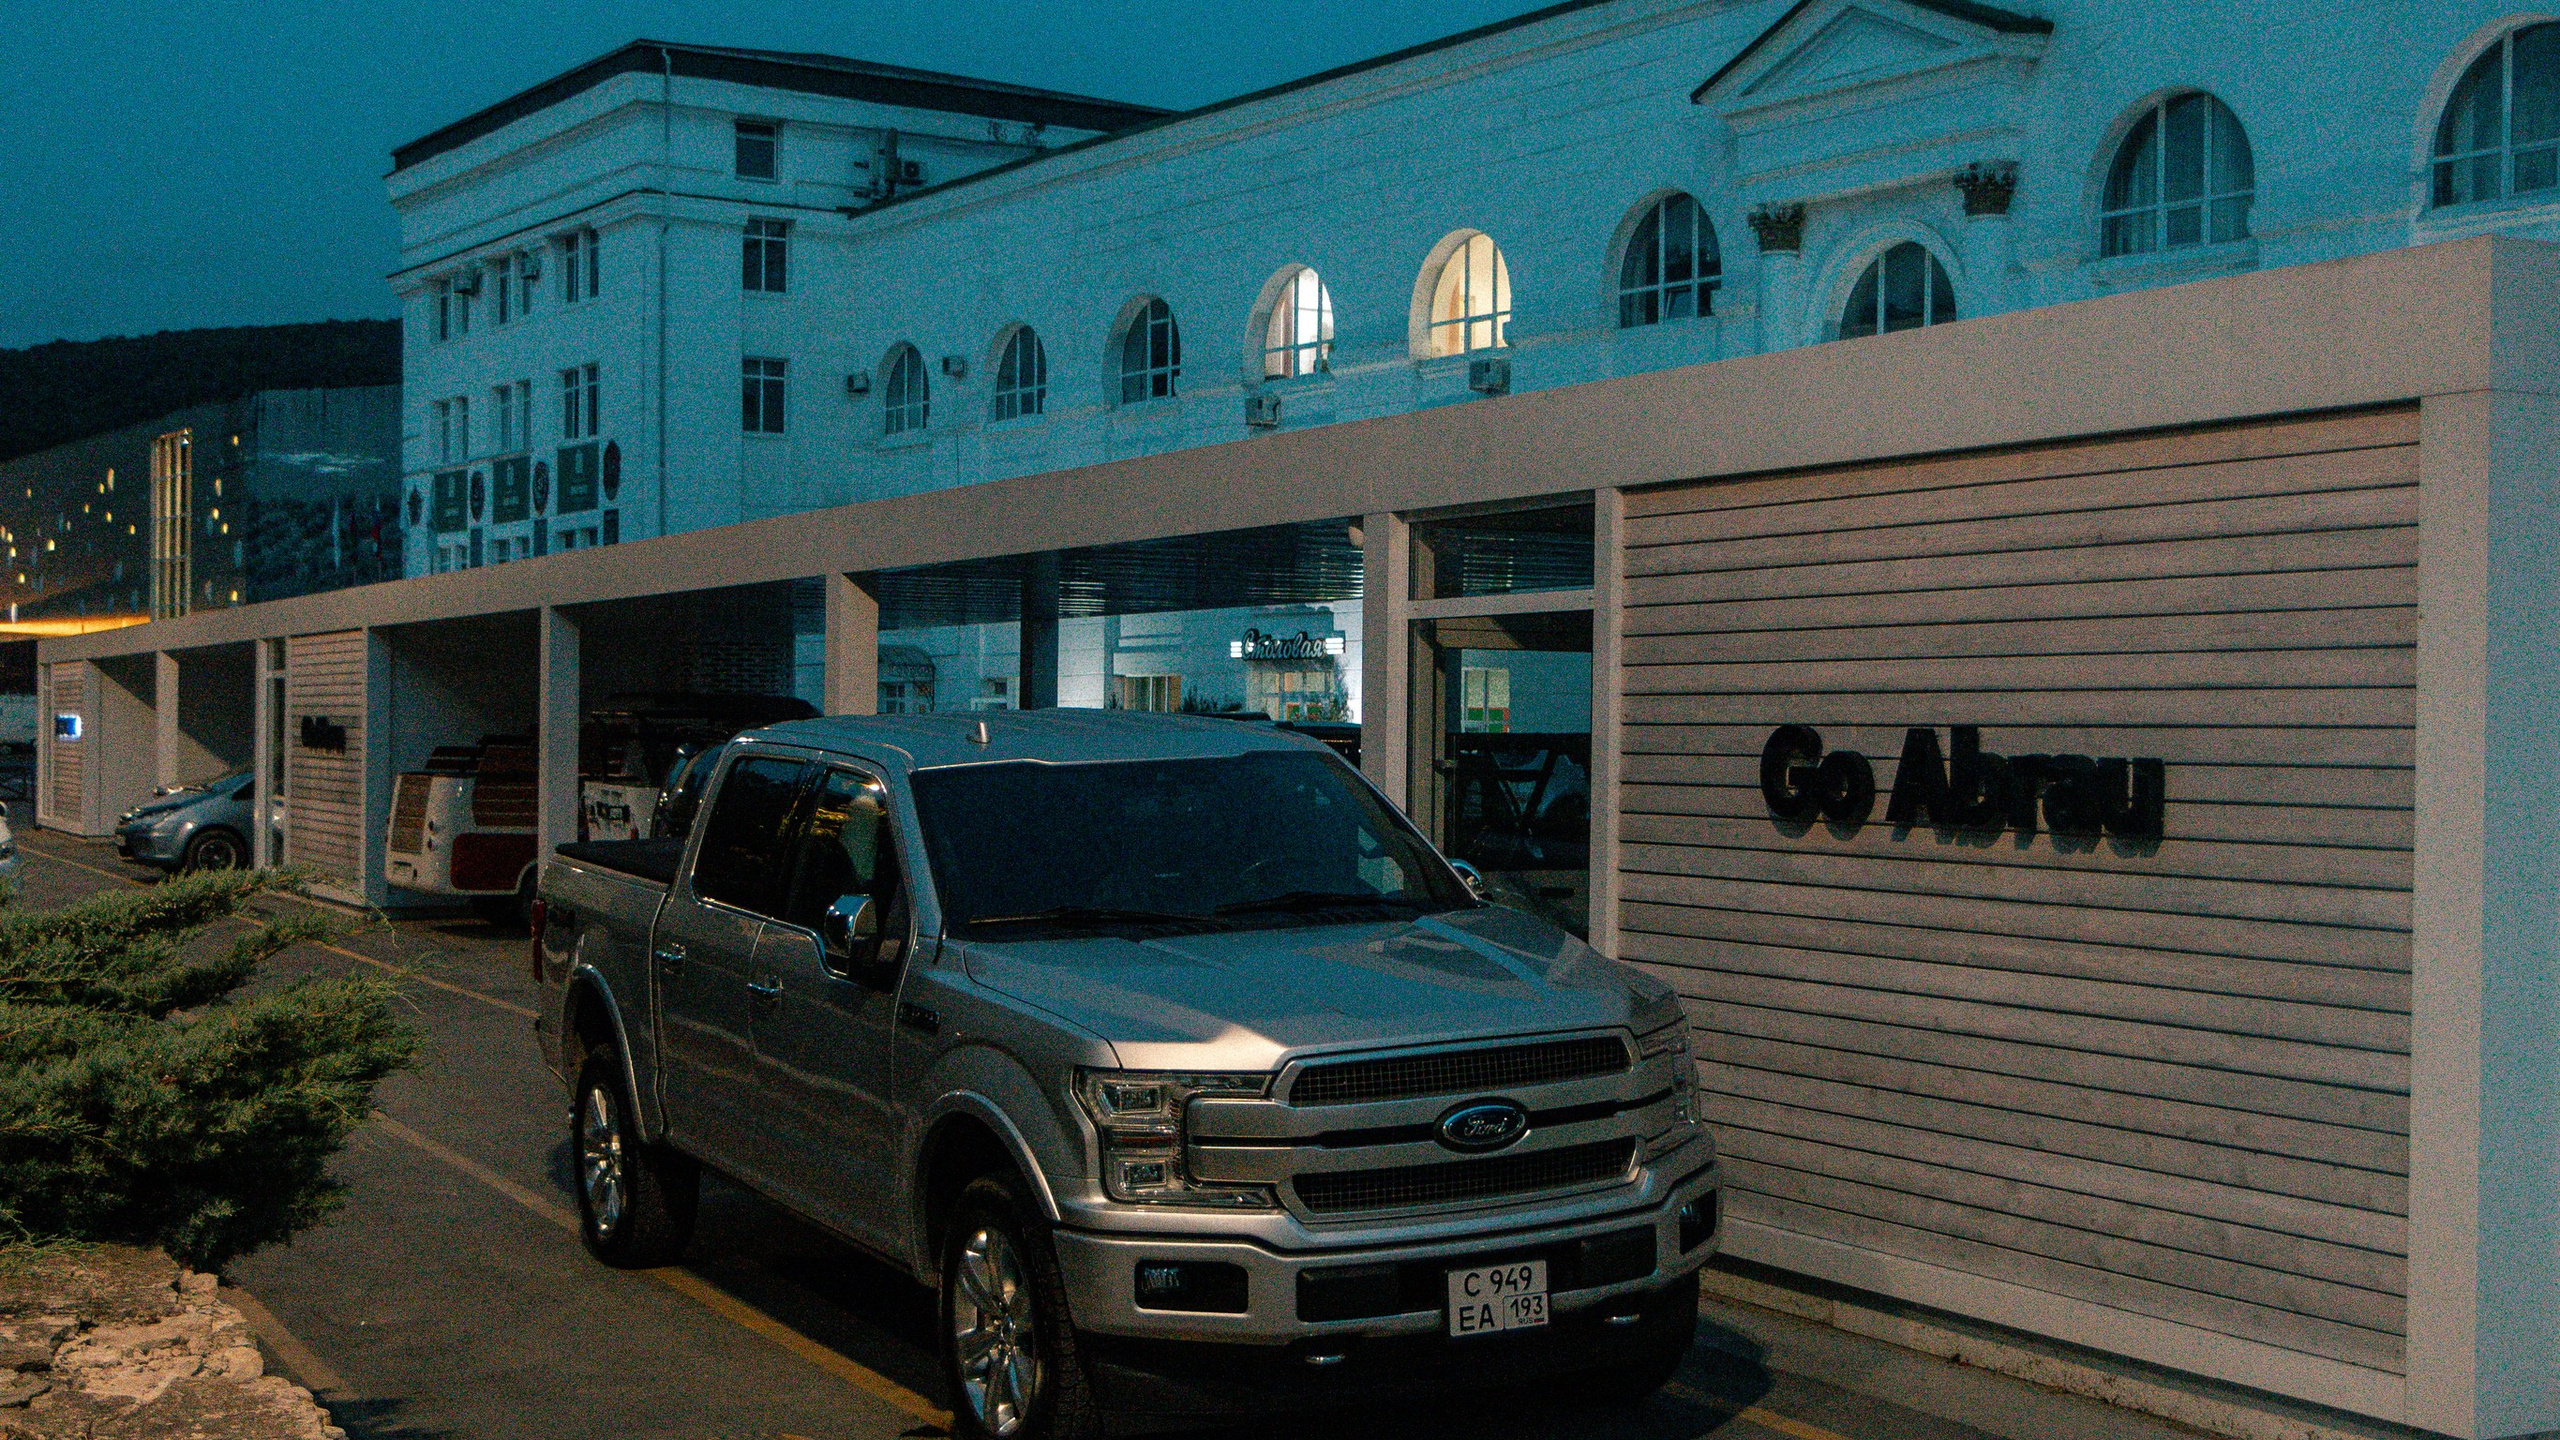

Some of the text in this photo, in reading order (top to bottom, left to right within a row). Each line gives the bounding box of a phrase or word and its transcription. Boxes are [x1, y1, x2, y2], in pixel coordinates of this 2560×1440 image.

[1242, 628, 1324, 660] Столовая
[1760, 724, 2166, 838] Go Abrau
[1463, 1114, 1507, 1137] Ford
[1489, 1264, 1533, 1295] 949
[1509, 1294, 1544, 1318] 193
